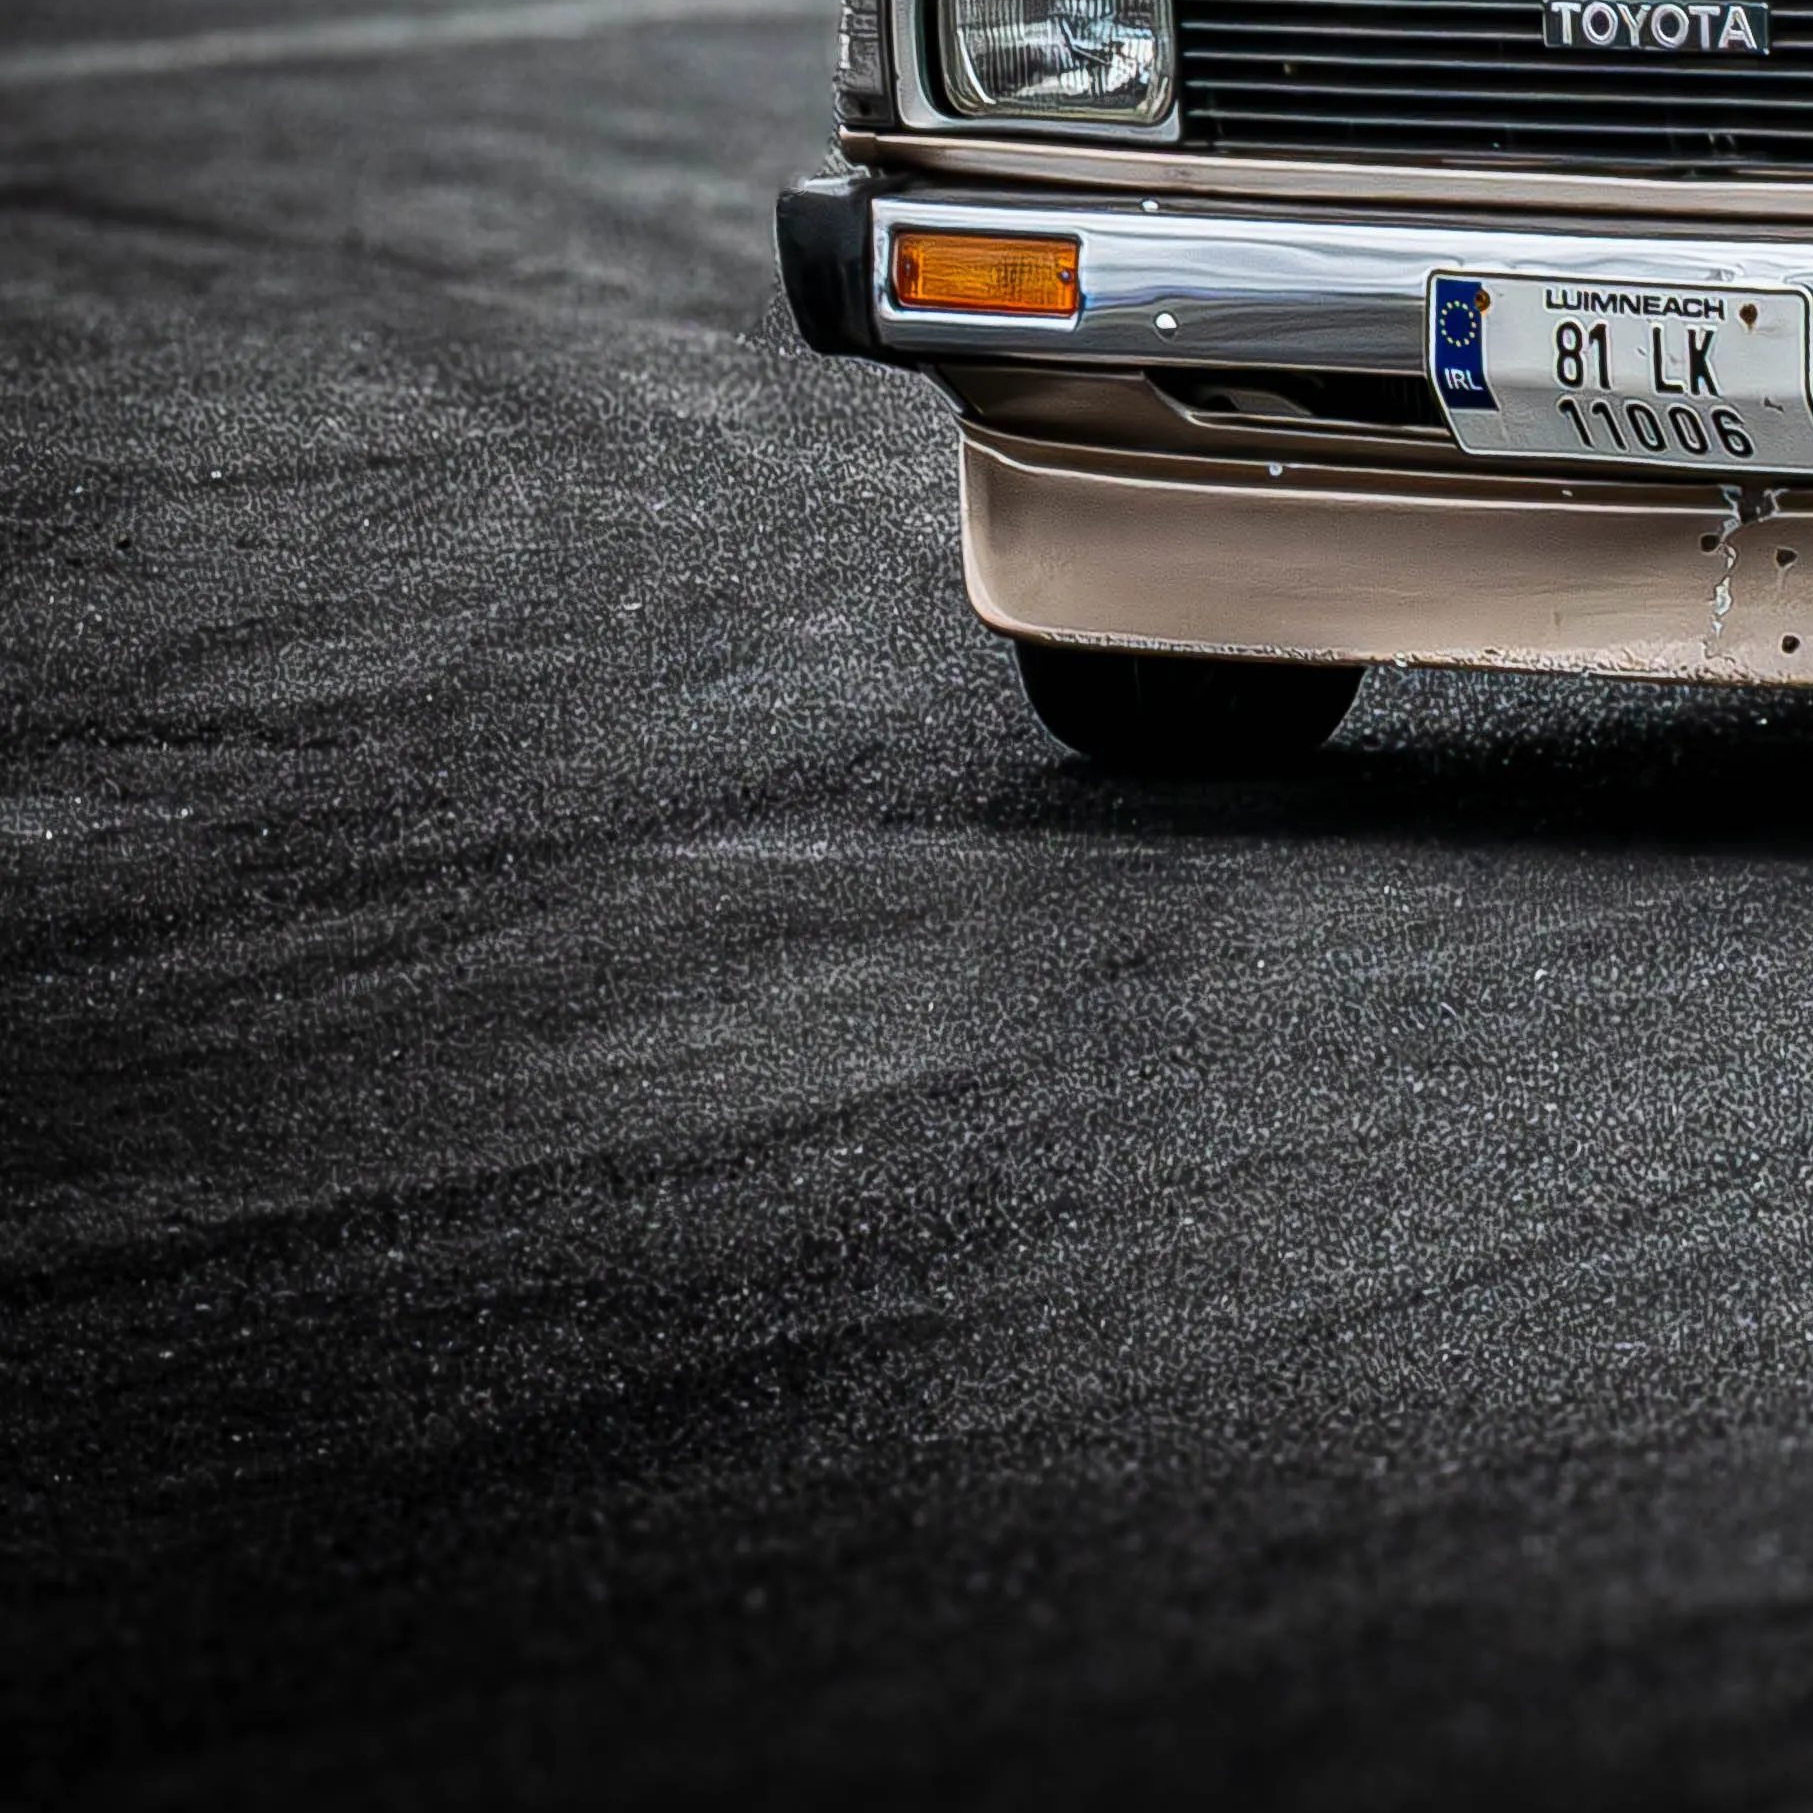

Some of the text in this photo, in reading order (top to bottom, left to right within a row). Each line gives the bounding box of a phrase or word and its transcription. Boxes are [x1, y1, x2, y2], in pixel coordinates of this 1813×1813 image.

[1551, 0, 1757, 50] TOYOTA
[1545, 289, 1725, 320] LUIMNEACH
[1444, 368, 1483, 391] IRL
[1555, 322, 1719, 396] 81 LK
[1557, 398, 1755, 458] 11006
